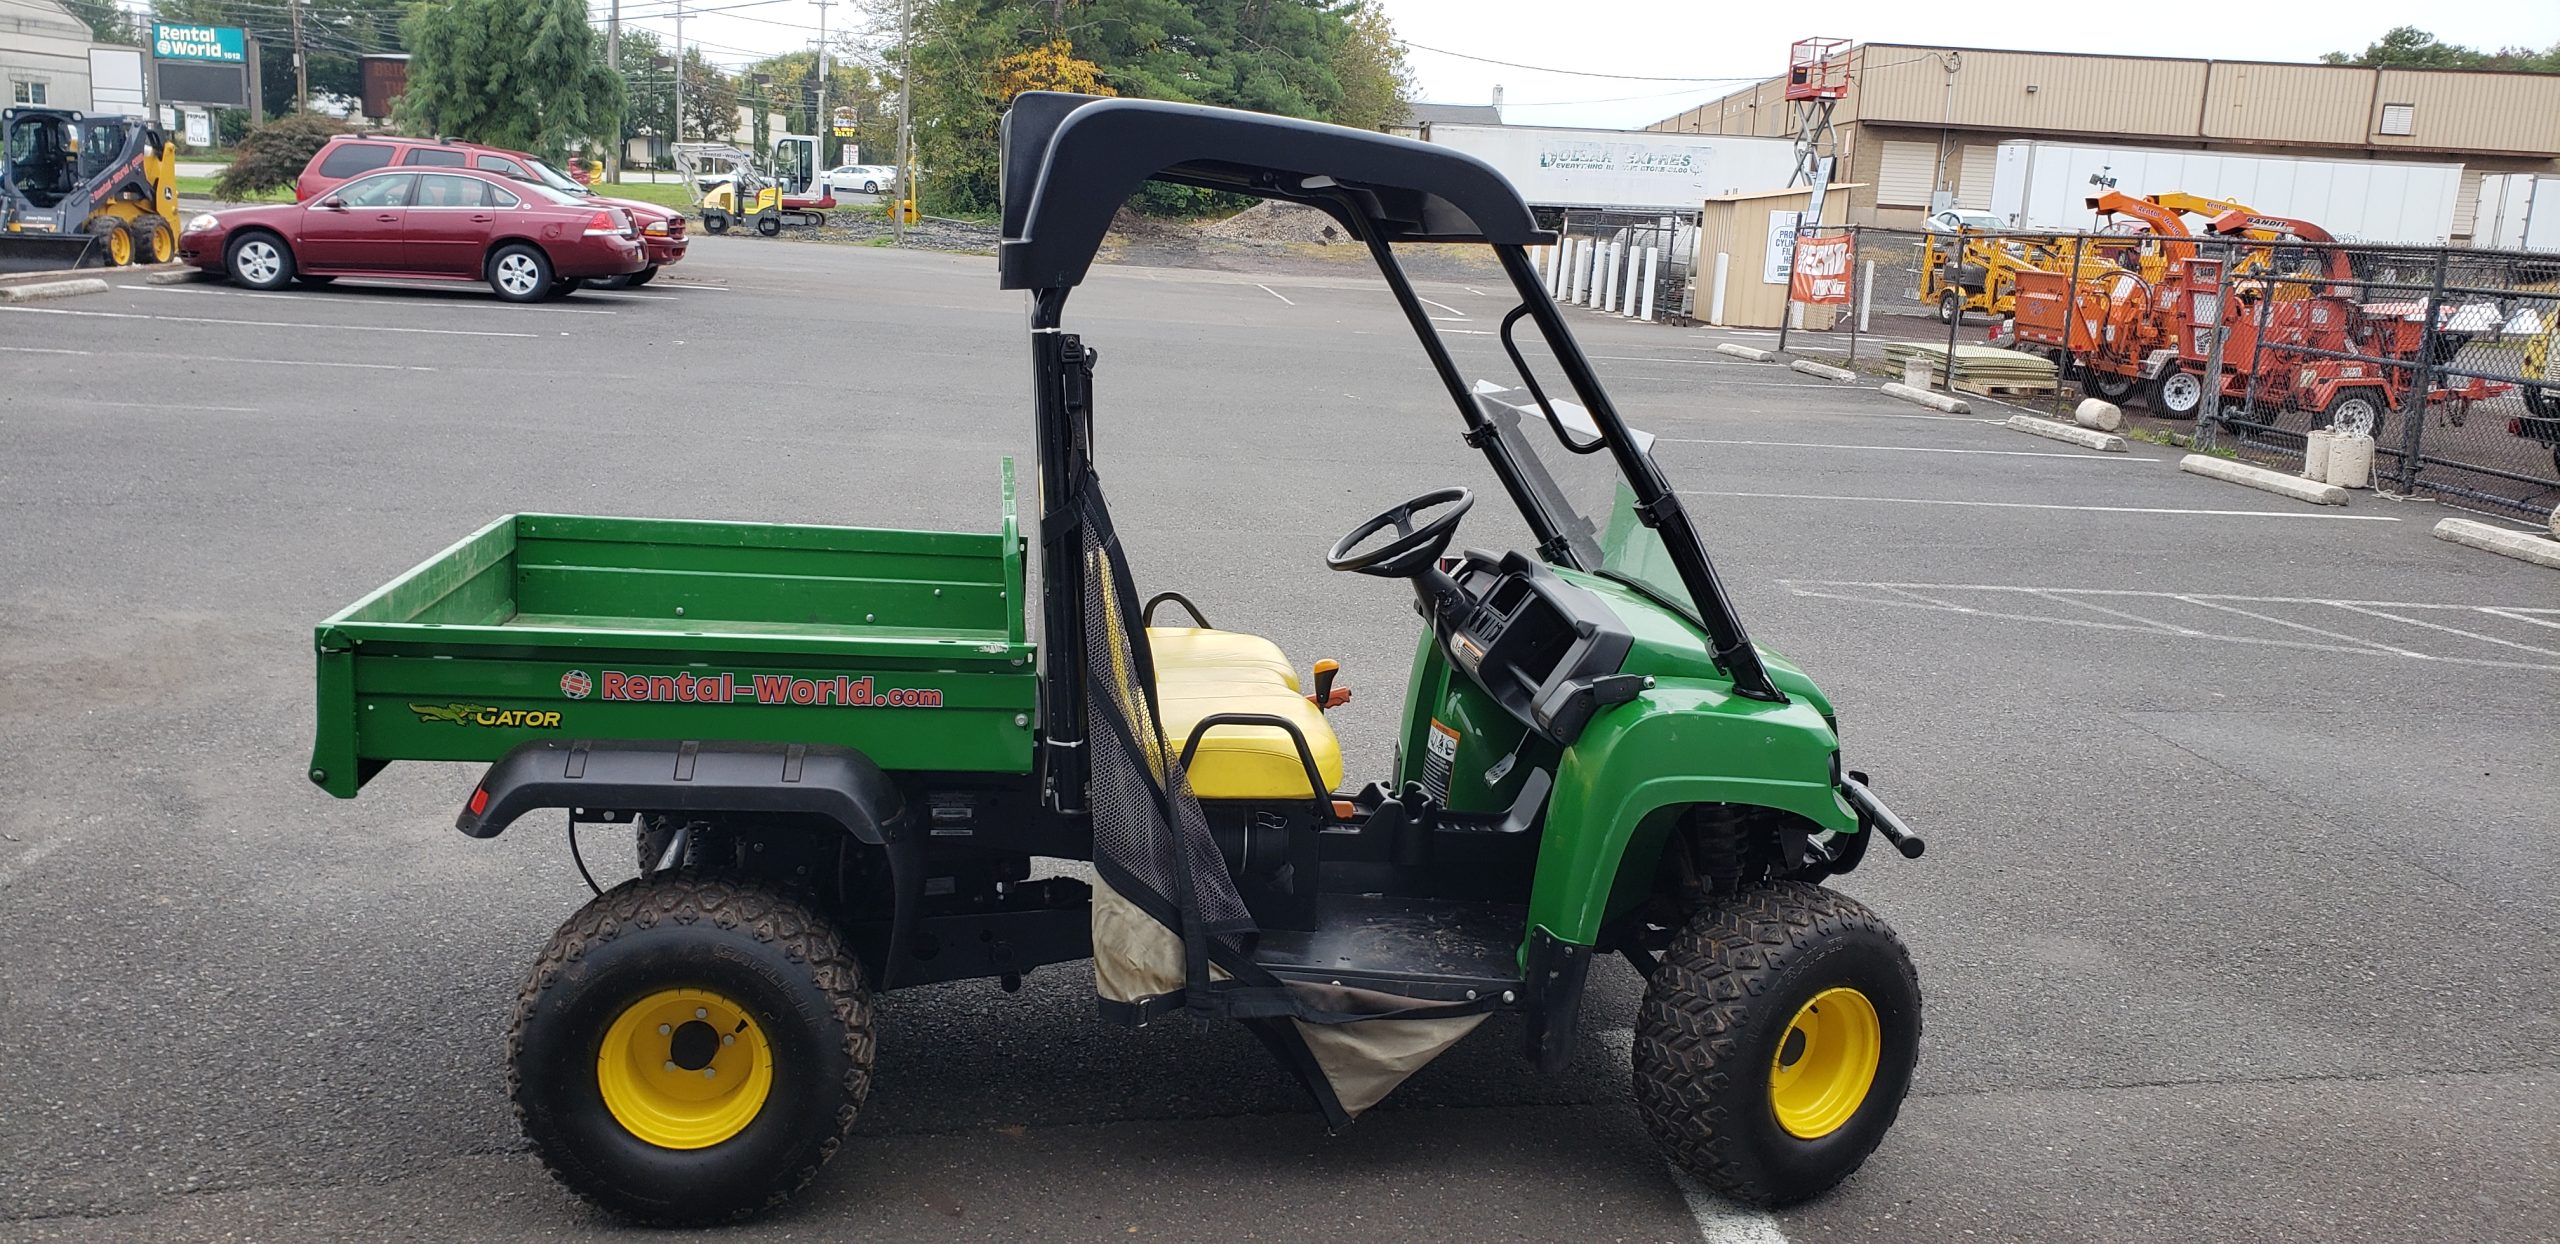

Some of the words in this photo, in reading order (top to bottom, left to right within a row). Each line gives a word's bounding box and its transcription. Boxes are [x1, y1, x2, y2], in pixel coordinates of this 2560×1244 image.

[160, 26, 215, 42] Rental
[171, 41, 222, 57] World
[2246, 216, 2288, 228] BANDIT
[602, 671, 943, 707] Rental-World.com
[476, 706, 561, 727] GATOR
